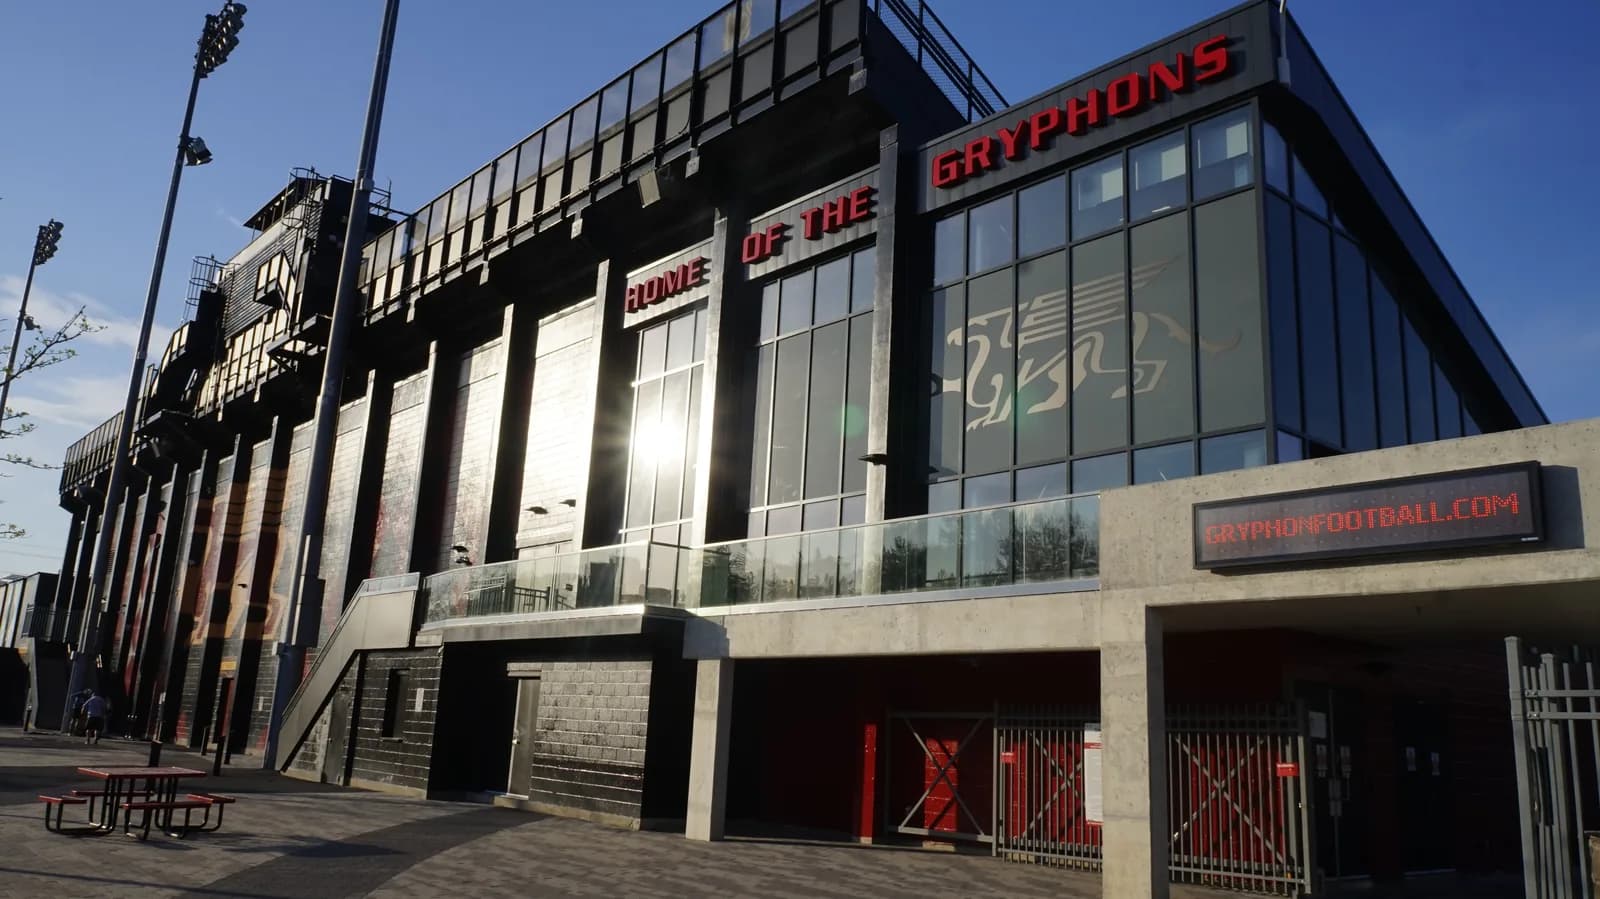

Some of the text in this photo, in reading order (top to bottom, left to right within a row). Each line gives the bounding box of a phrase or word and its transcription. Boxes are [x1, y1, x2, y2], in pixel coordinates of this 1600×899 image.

[624, 34, 1228, 313] HOME OF THE GRYPHONS
[1205, 492, 1519, 545] GRYPHONFOOTBALL.COM
